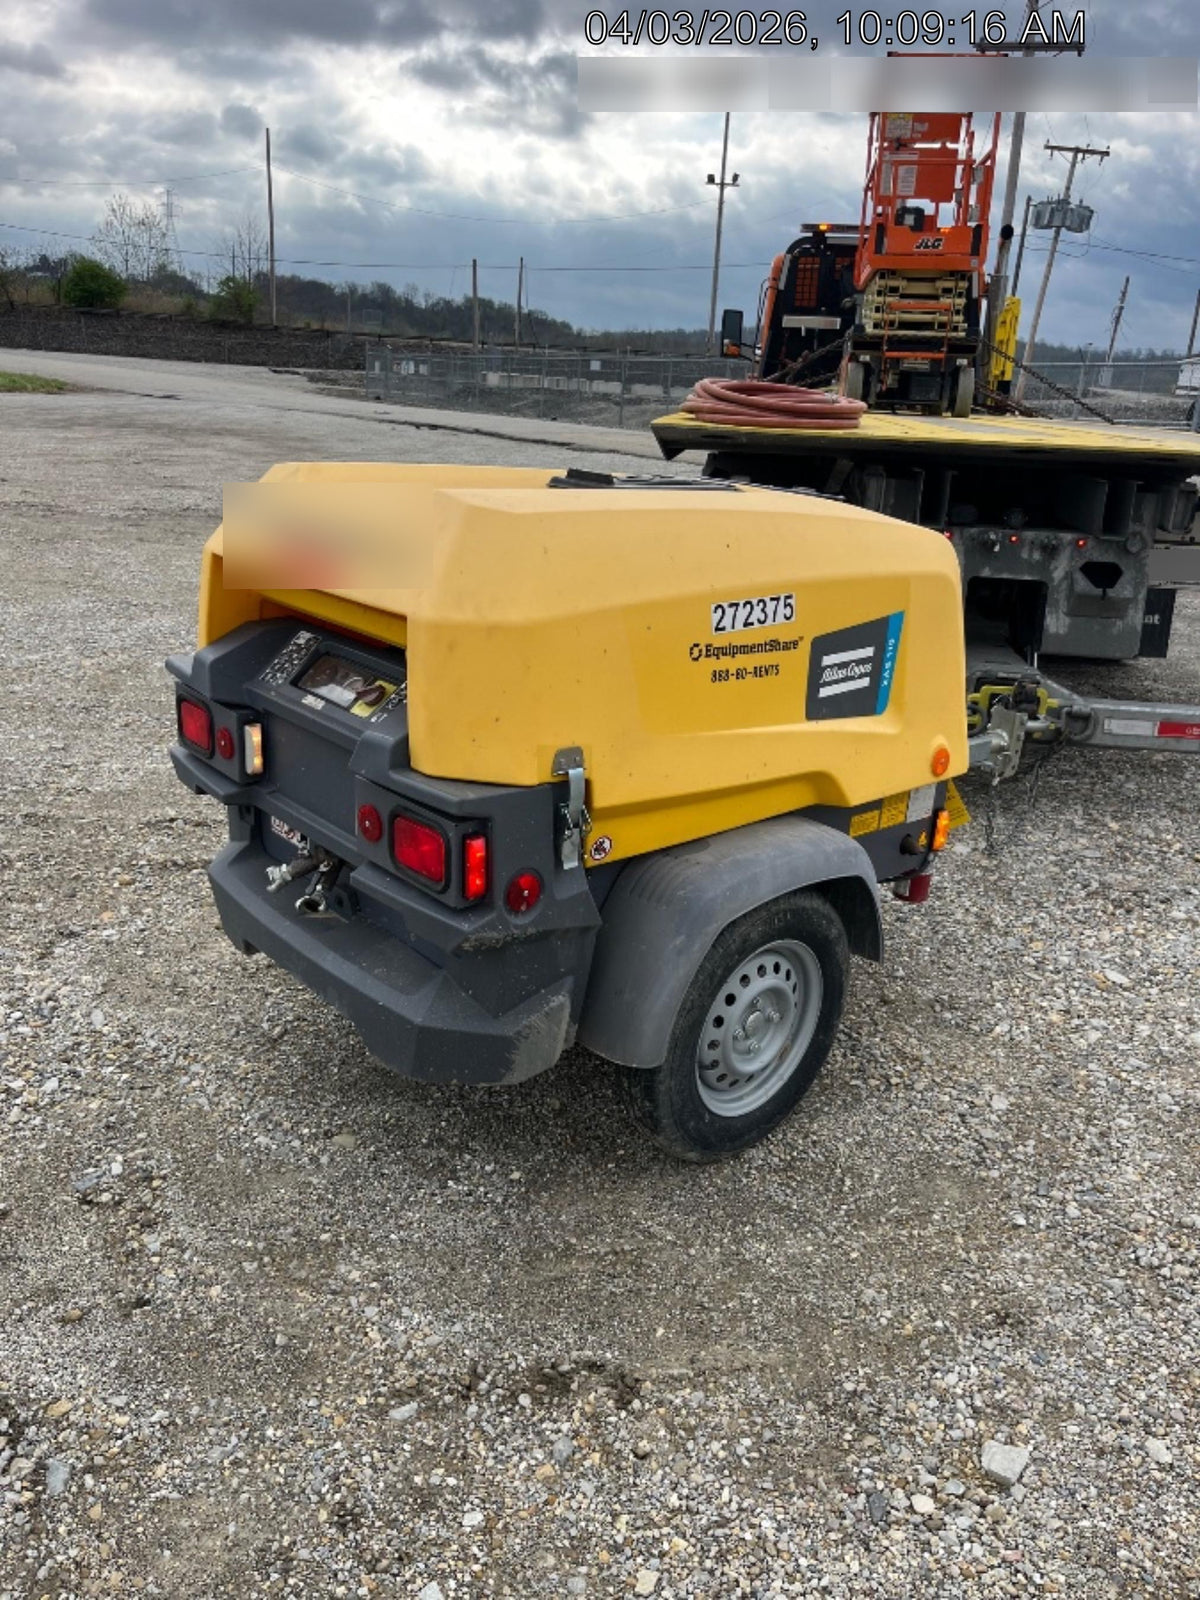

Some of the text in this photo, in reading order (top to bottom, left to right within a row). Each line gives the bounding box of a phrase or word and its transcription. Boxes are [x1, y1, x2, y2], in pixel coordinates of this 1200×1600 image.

[912, 236, 944, 251] JLG
[713, 594, 794, 633] 272375
[819, 662, 872, 683] Atlas Copco
